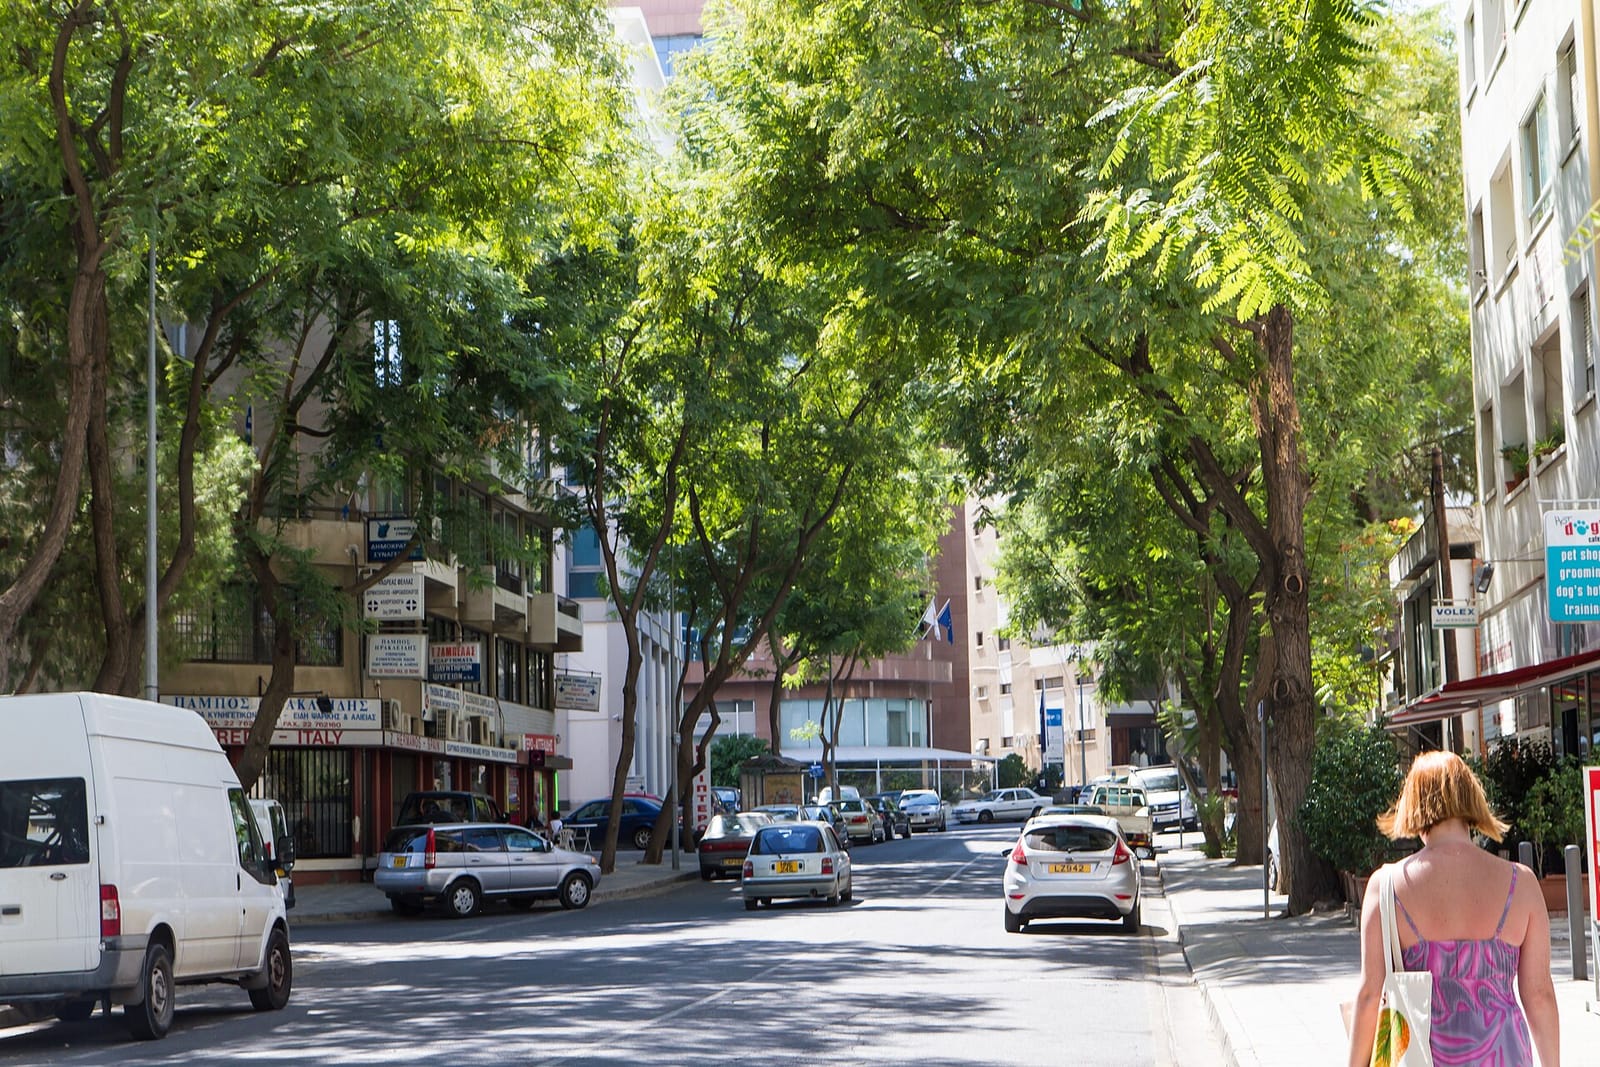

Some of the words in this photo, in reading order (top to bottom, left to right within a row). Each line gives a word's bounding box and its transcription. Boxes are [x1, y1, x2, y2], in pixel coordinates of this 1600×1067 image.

[1561, 549, 1577, 562] pet
[1556, 584, 1583, 599] dog's
[1436, 608, 1474, 616] VOLEX
[174, 696, 249, 709] ΠΑΜΠΟΣ
[293, 712, 309, 720] ΕΙΔΗ
[343, 713, 348, 721] &
[298, 730, 343, 745] ITALY
